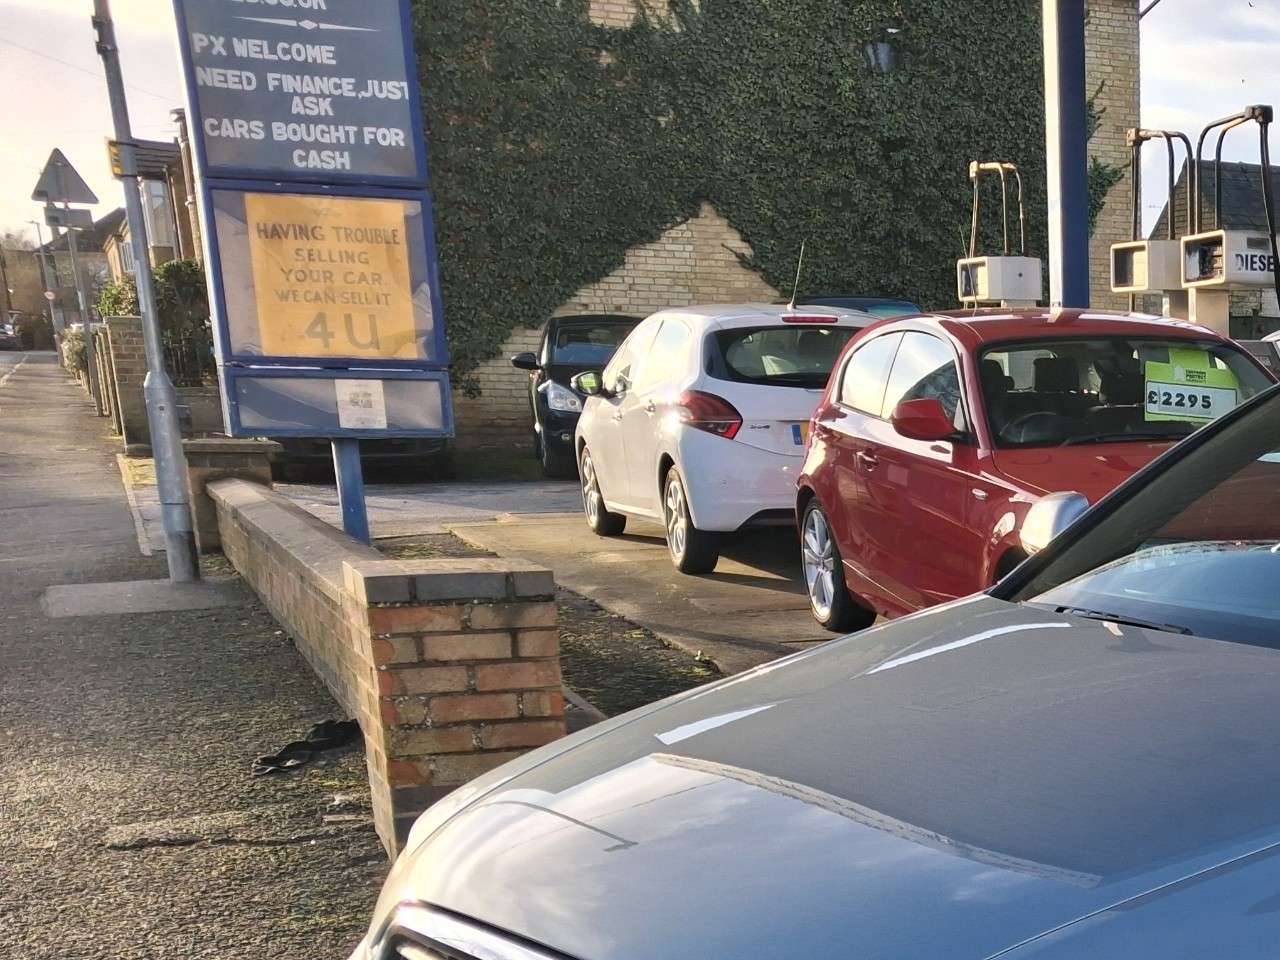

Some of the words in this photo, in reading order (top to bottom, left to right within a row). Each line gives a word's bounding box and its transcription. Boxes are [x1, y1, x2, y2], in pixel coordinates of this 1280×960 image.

[191, 33, 227, 56] PX
[232, 37, 337, 65] WELCOME
[196, 66, 257, 91] NEED
[291, 96, 335, 117] ASK
[204, 118, 265, 140] CARS
[271, 121, 358, 145] BOUGHT
[363, 126, 405, 147] FOR
[293, 149, 351, 170] CASH
[256, 222, 325, 242] HAVING
[332, 226, 400, 246] TROUBLE
[294, 248, 370, 265] SELLING
[281, 267, 334, 284] YOUR
[343, 271, 383, 286] CAR
[275, 289, 299, 304] WE
[304, 290, 337, 305] CAN
[340, 291, 374, 305] SELL
[376, 292, 391, 306] IT
[304, 312, 335, 350] 4
[344, 313, 380, 351] U
[1148, 391, 1212, 409] £2295
